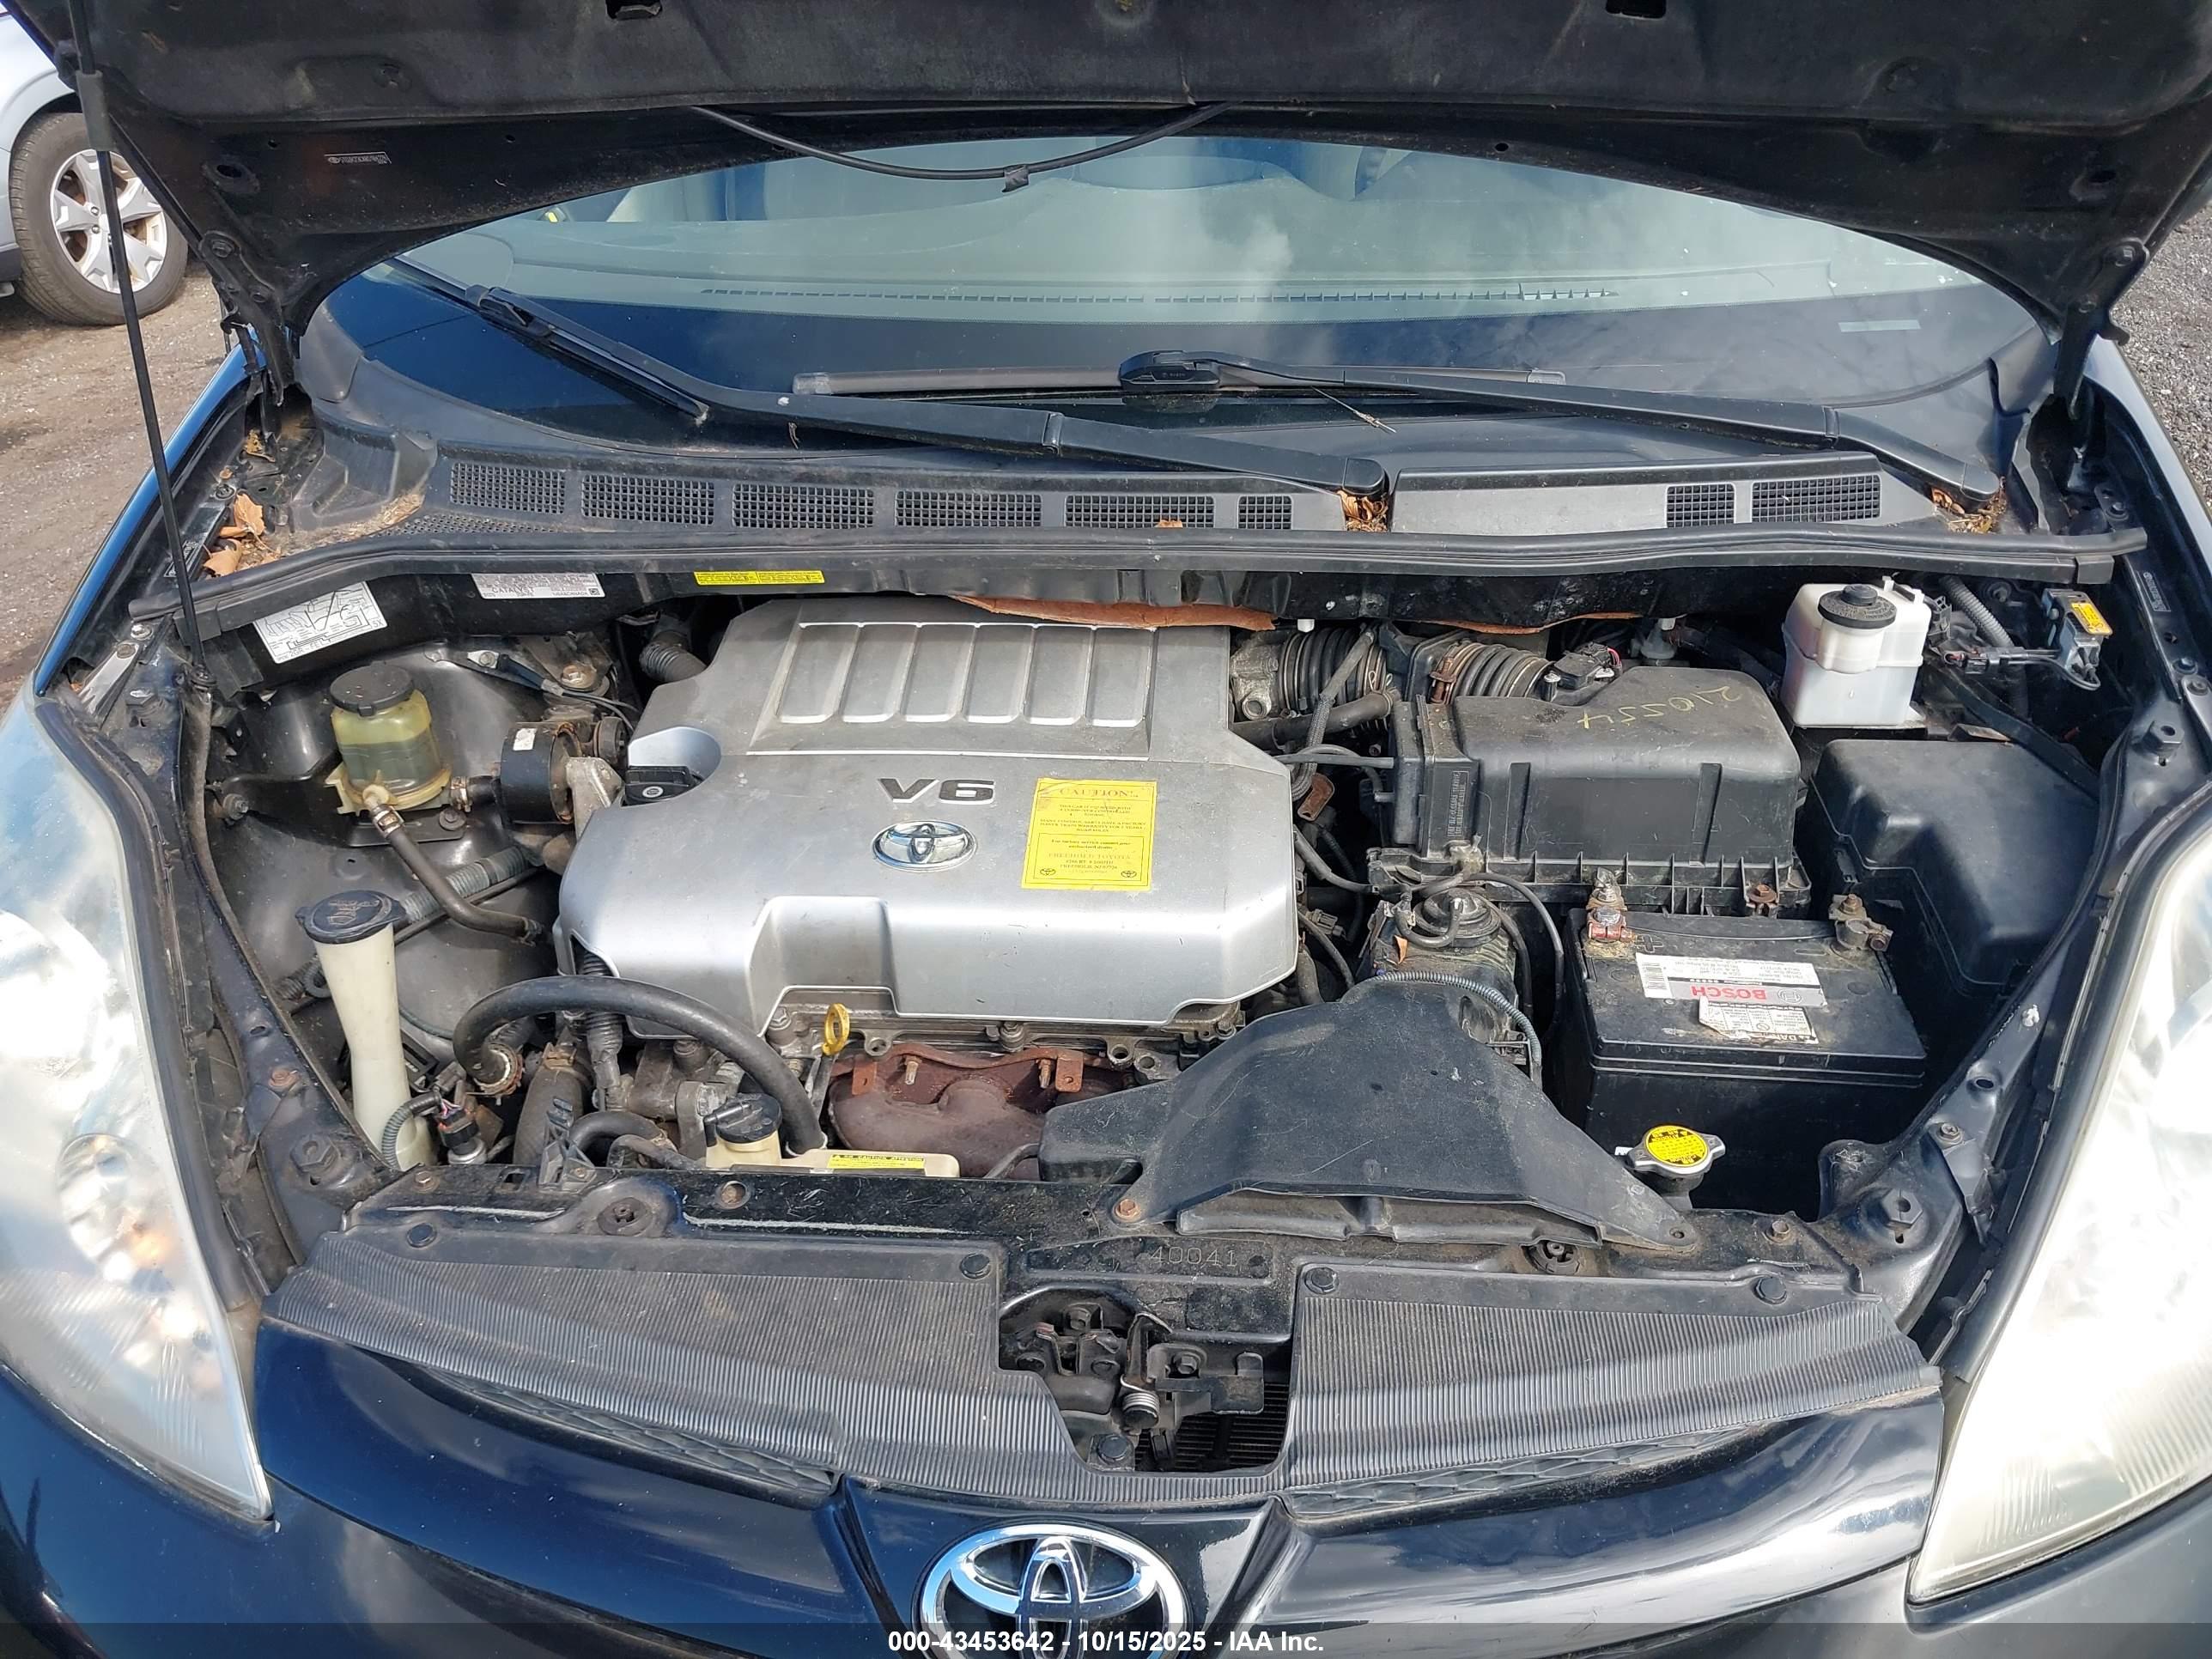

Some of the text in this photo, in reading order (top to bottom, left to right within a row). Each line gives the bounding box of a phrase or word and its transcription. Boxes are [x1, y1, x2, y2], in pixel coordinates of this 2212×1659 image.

[878, 777, 995, 805] V6
[1691, 985, 1766, 1000] BOSCH
[1150, 1245, 1237, 1267] 40041
